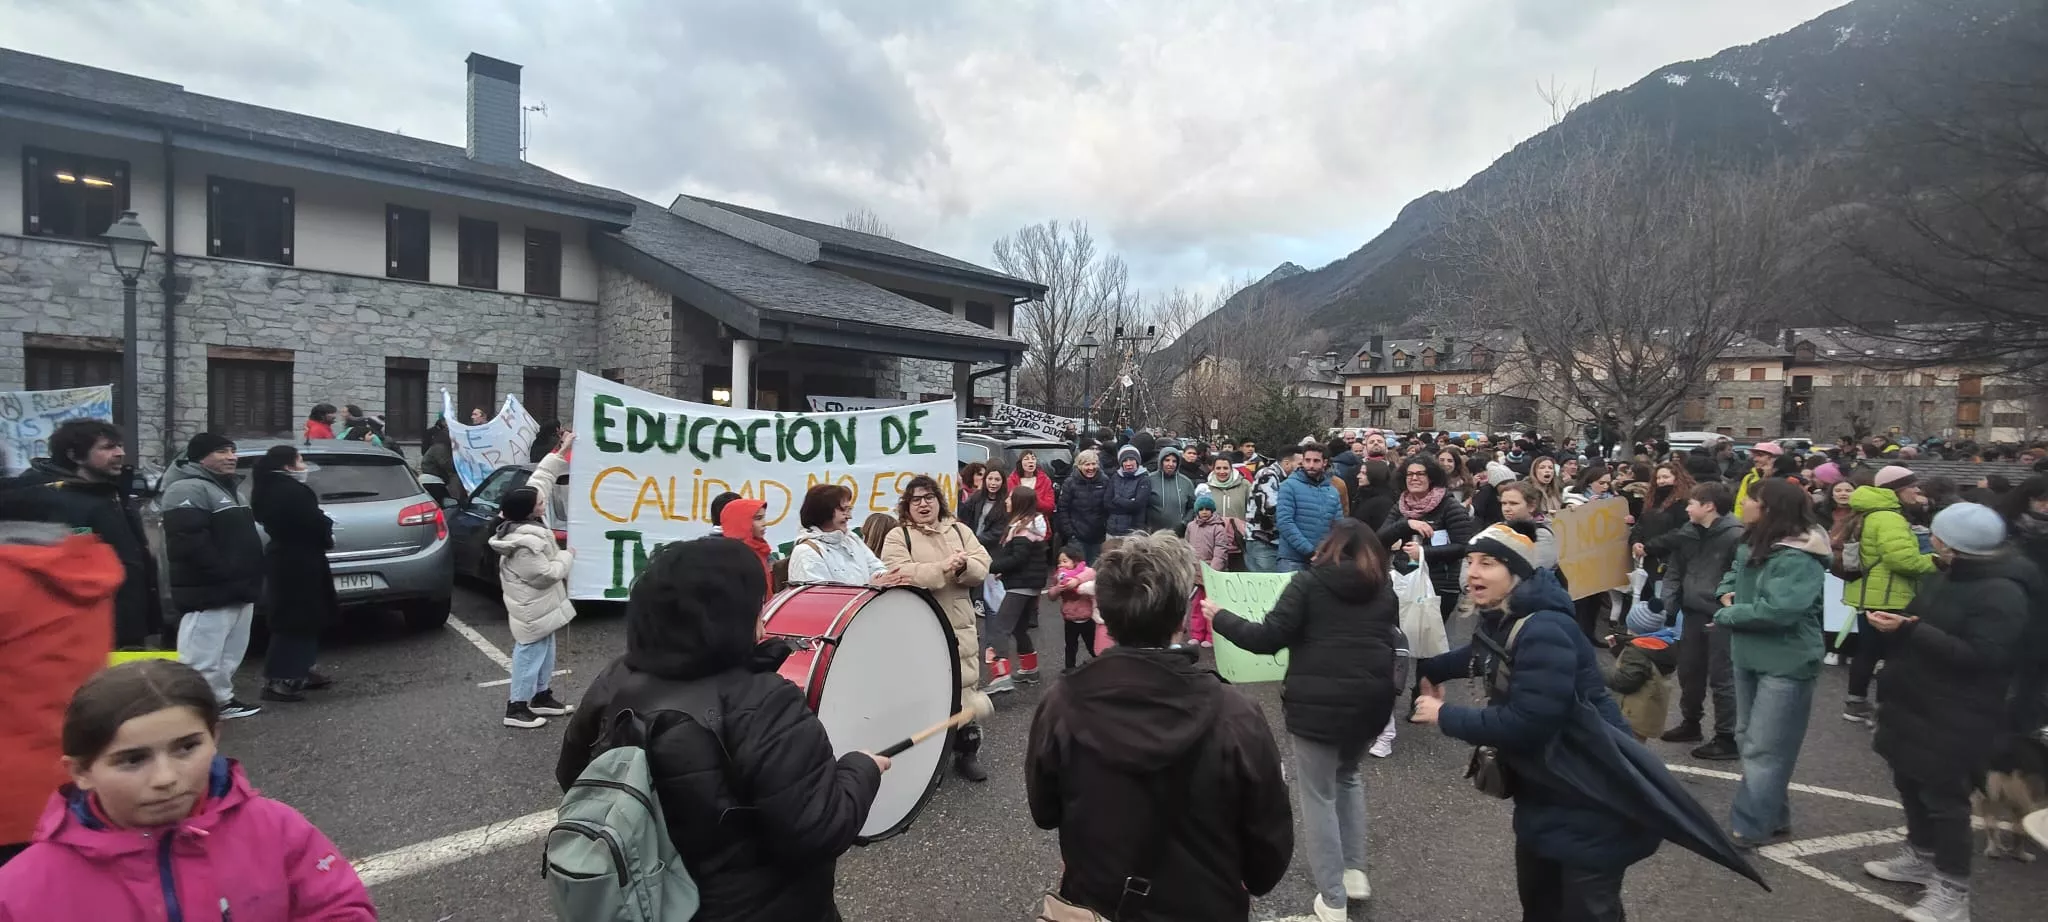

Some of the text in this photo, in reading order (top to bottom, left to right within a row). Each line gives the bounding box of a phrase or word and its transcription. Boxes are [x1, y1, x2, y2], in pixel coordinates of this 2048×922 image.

[594, 393, 936, 465] EDUCACIÓN DE
[340, 575, 369, 588] HVR
